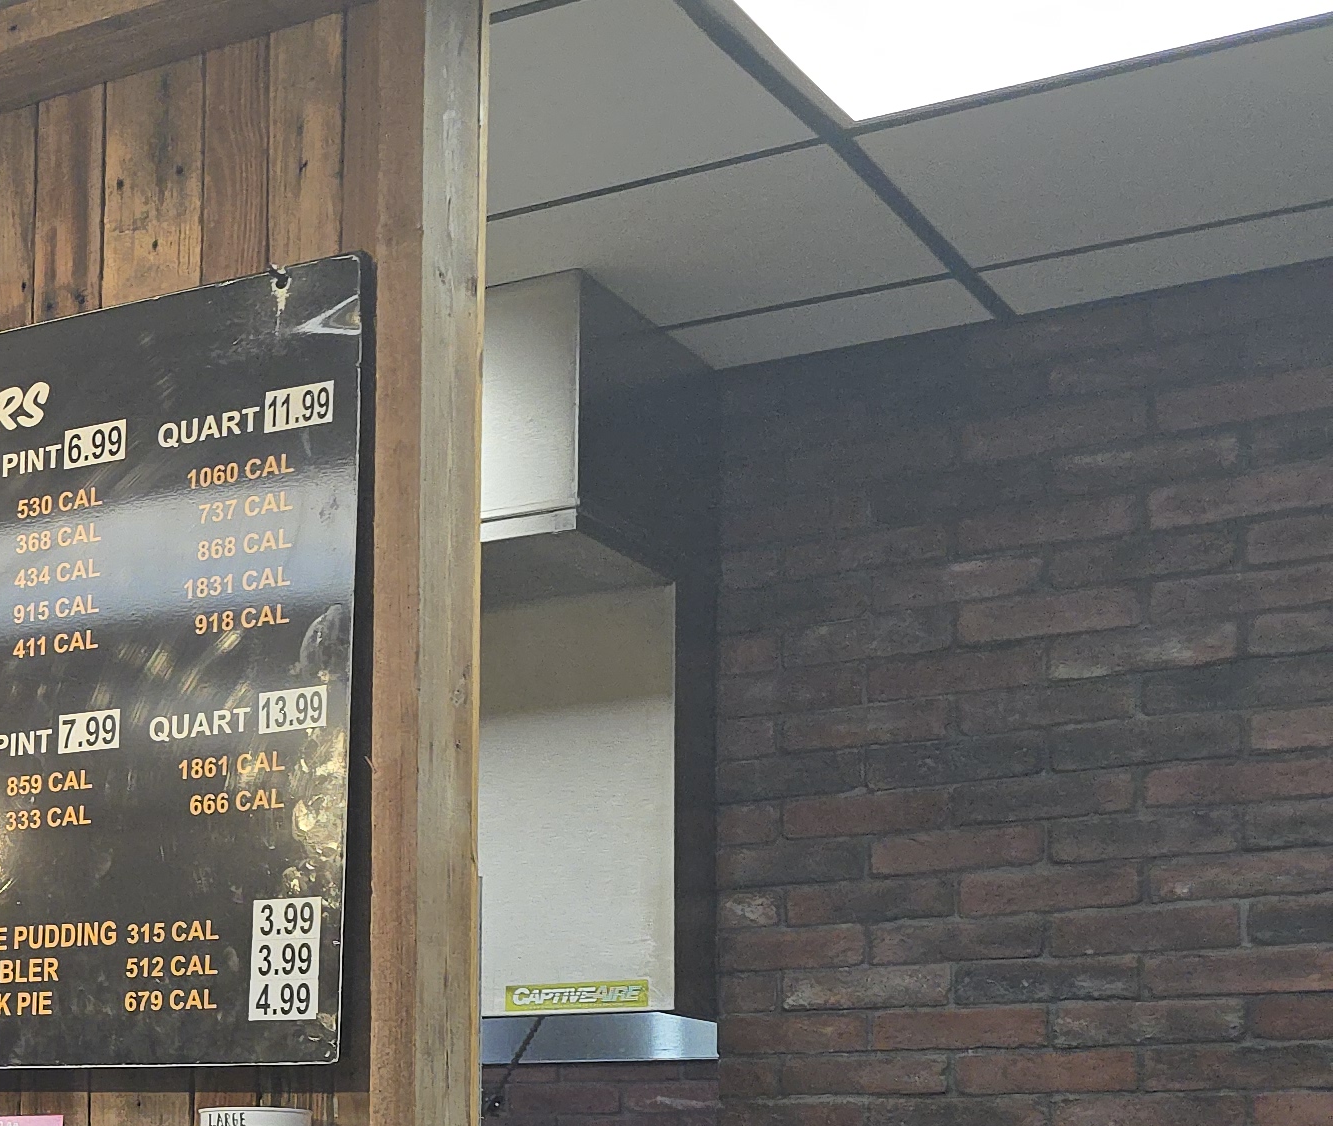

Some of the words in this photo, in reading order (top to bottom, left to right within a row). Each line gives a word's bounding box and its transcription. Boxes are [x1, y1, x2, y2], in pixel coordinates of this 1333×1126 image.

[157, 406, 259, 448] QUART
[267, 387, 329, 430] 11.99
[2, 444, 61, 477] PINT
[68, 425, 122, 464] 6.99
[187, 462, 238, 489] 1060
[245, 454, 295, 479] CAL
[16, 495, 52, 519] 530
[58, 487, 103, 512] CAL
[209, 1112, 246, 1126] LARGE
